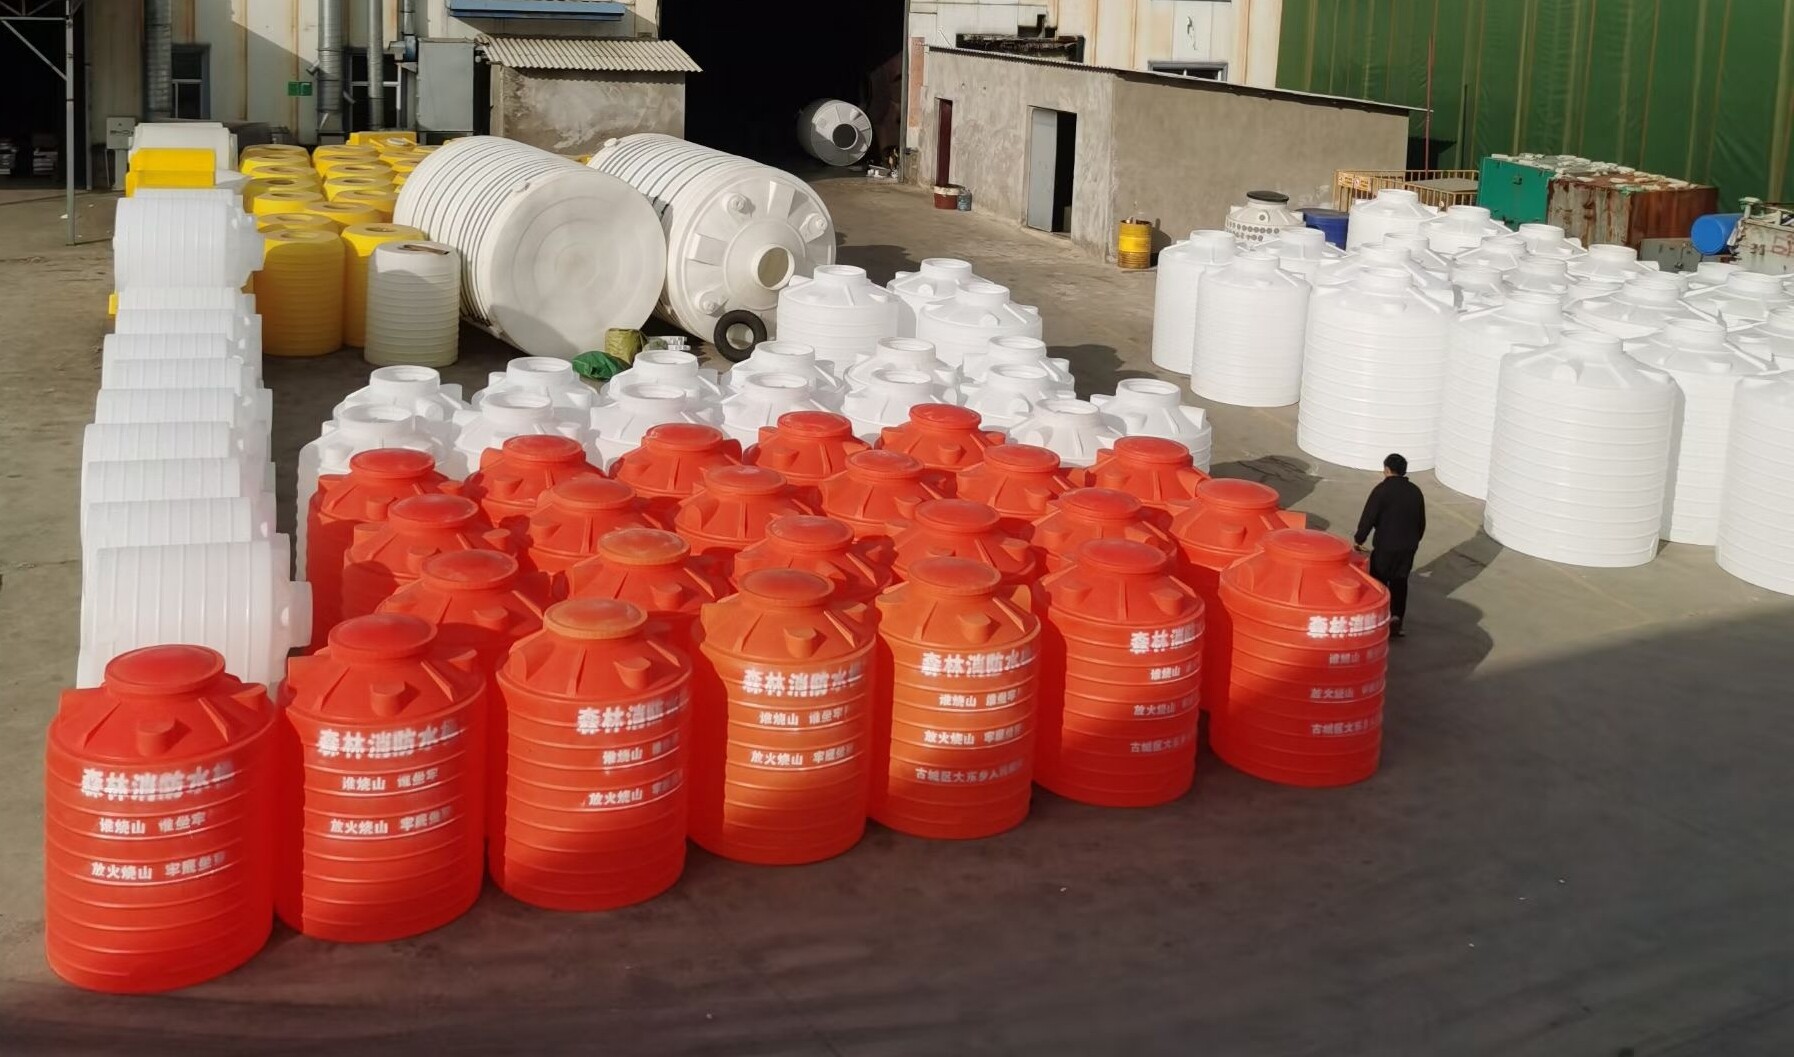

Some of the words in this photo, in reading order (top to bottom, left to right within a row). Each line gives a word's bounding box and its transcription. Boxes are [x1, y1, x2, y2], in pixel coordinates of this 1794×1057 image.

[1307, 609, 1386, 638] 森林消防
[750, 750, 803, 766] 放火烧山
[330, 818, 389, 835] 放火烧山
[91, 861, 153, 880] 放火烧山
